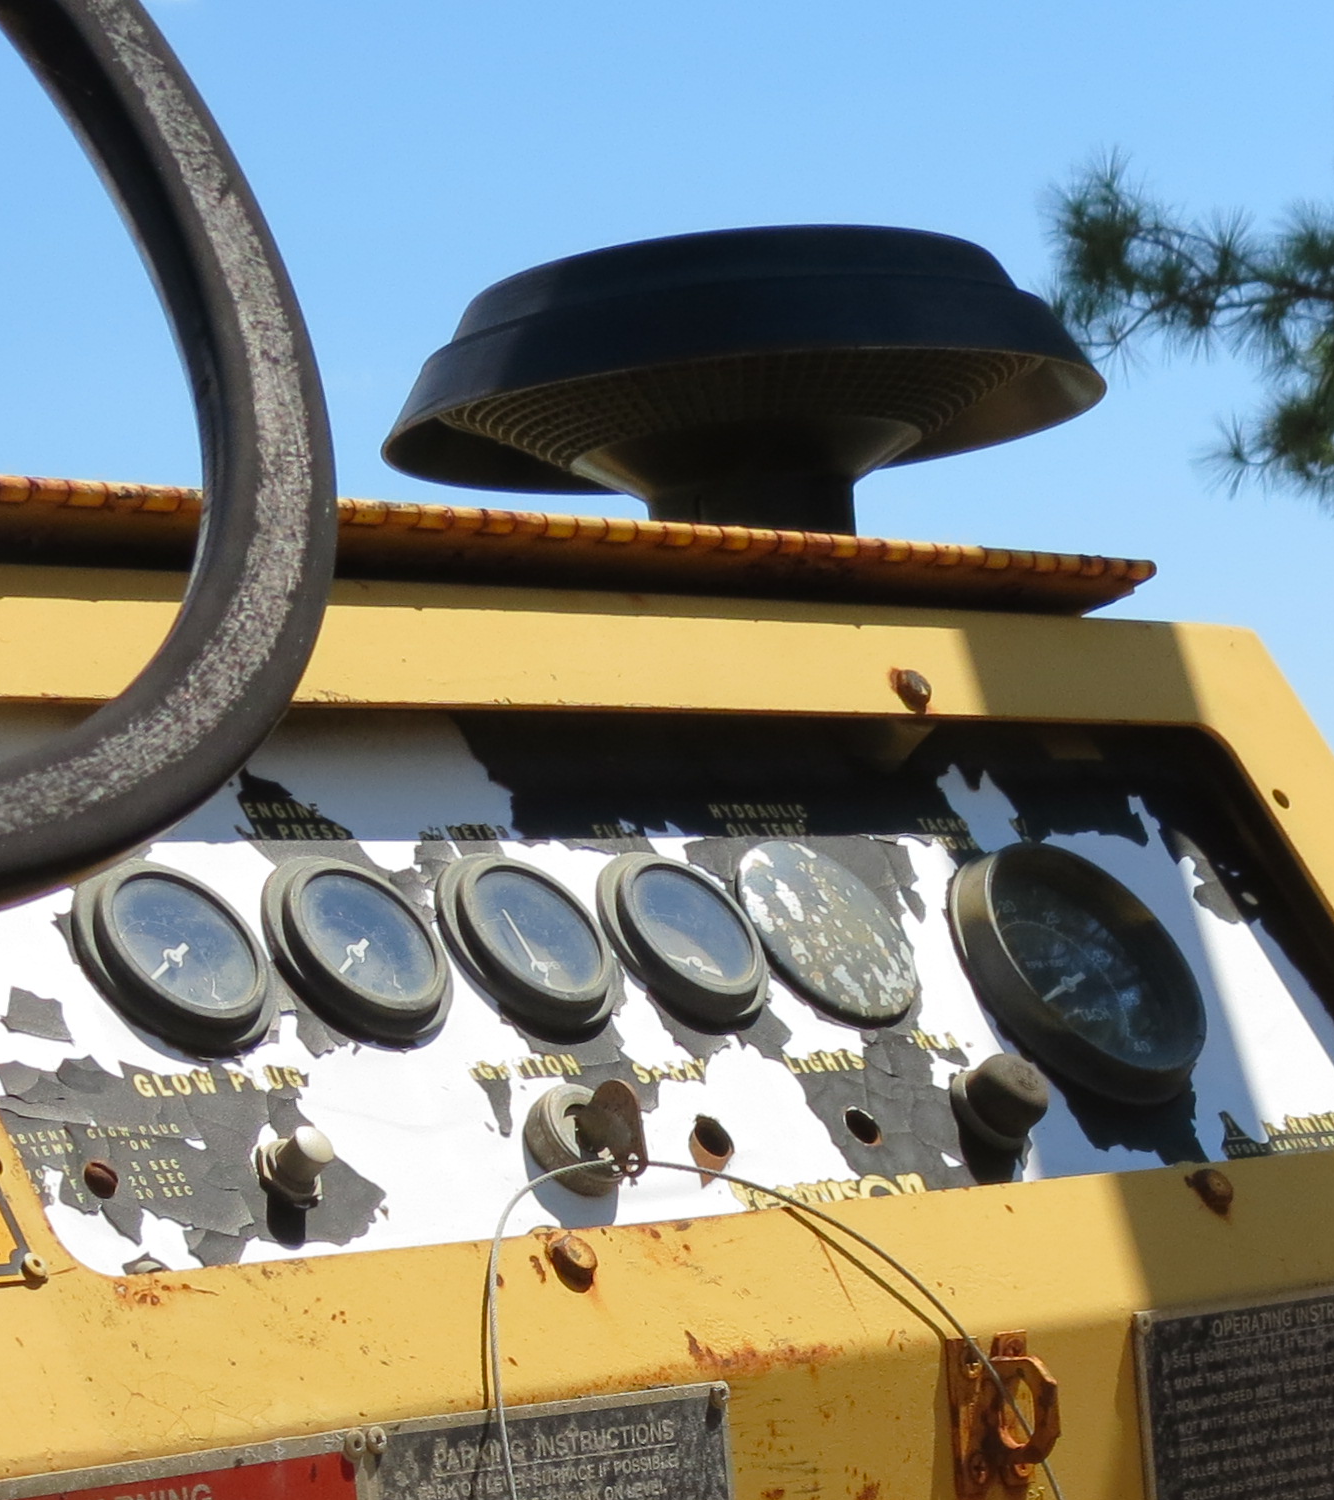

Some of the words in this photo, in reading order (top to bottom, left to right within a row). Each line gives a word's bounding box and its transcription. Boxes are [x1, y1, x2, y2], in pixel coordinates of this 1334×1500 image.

[242, 802, 323, 819] ENGINE
[708, 803, 809, 819] HYDRAULIC
[278, 823, 349, 840] PRESS
[724, 822, 757, 838] OIL
[783, 1049, 866, 1075] LIGHTS
[132, 1069, 216, 1099] GLOW
[86, 1126, 130, 1140] GLOW
[138, 1123, 182, 1136] PLUG
[1270, 1137, 1318, 1152] LEAVING
[131, 1161, 141, 1173] 5
[149, 1158, 181, 1171] SEC
[127, 1174, 148, 1188] 20
[155, 1171, 188, 1184] SEC
[162, 1185, 195, 1199] SEC
[1211, 1308, 1292, 1338] OPERATING
[534, 1419, 675, 1458] INSTRUCTIONS
